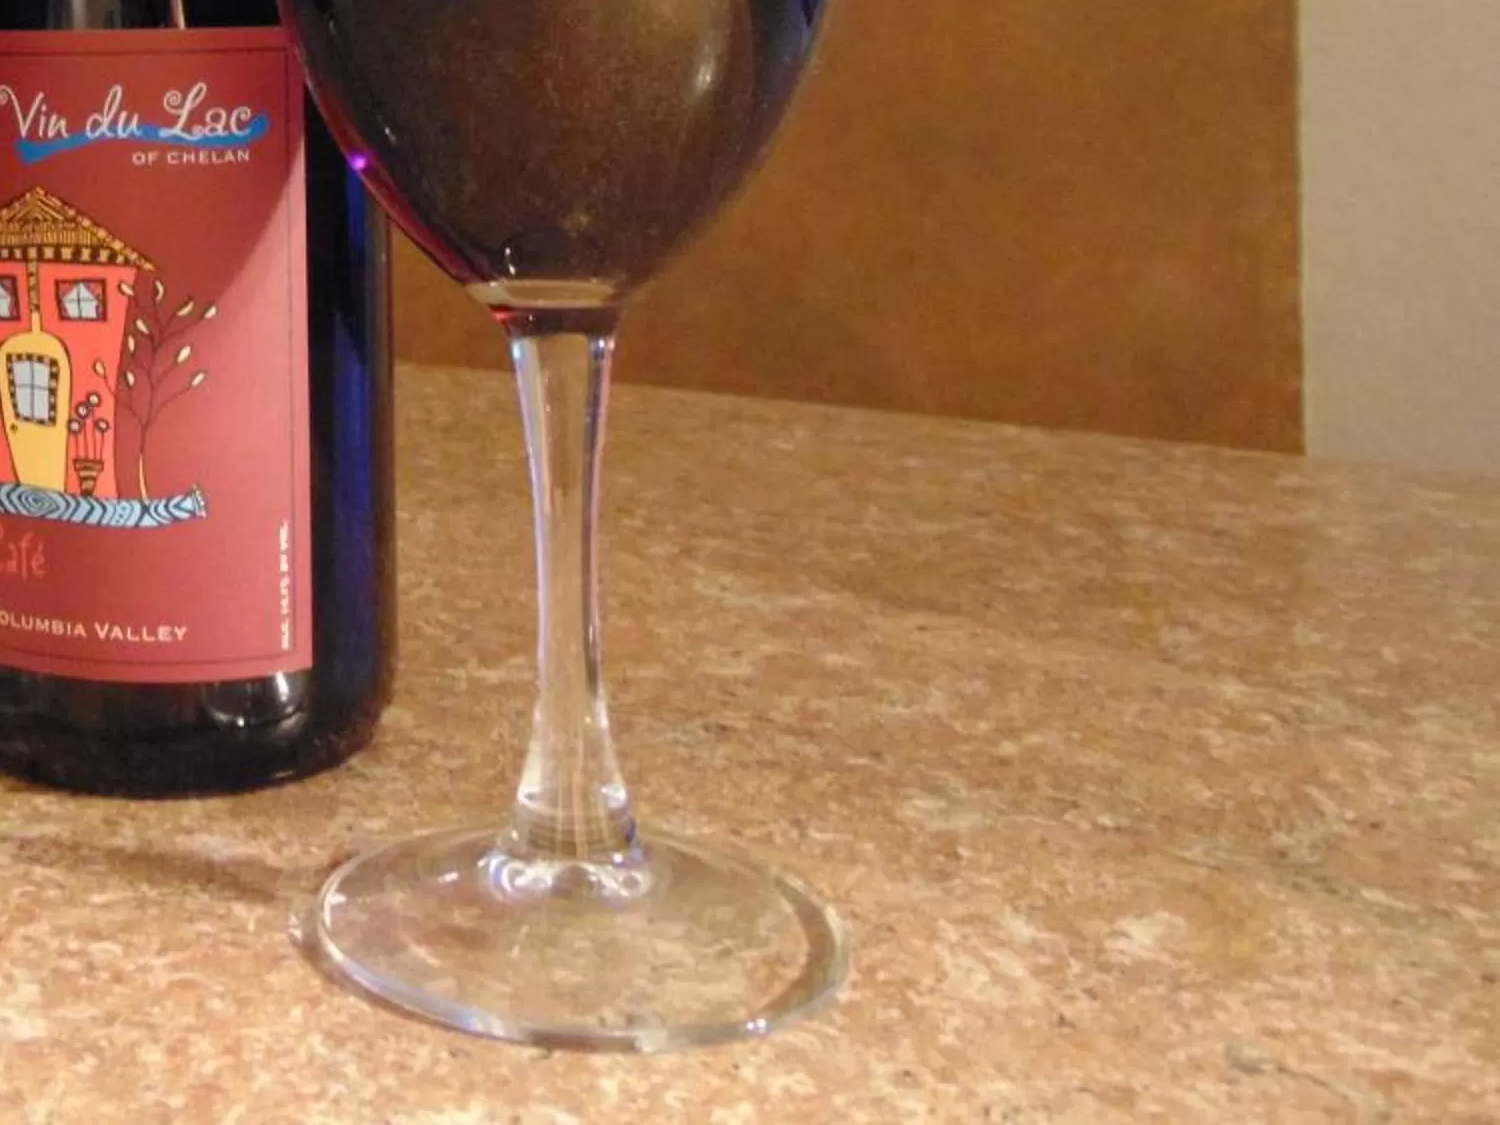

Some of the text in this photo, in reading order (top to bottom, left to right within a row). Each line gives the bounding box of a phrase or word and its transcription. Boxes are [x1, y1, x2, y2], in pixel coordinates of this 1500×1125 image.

[85, 84, 141, 140] du
[158, 81, 254, 141] Lac
[132, 149, 251, 166] OF CHELAN
[94, 622, 188, 642] VALLEY
